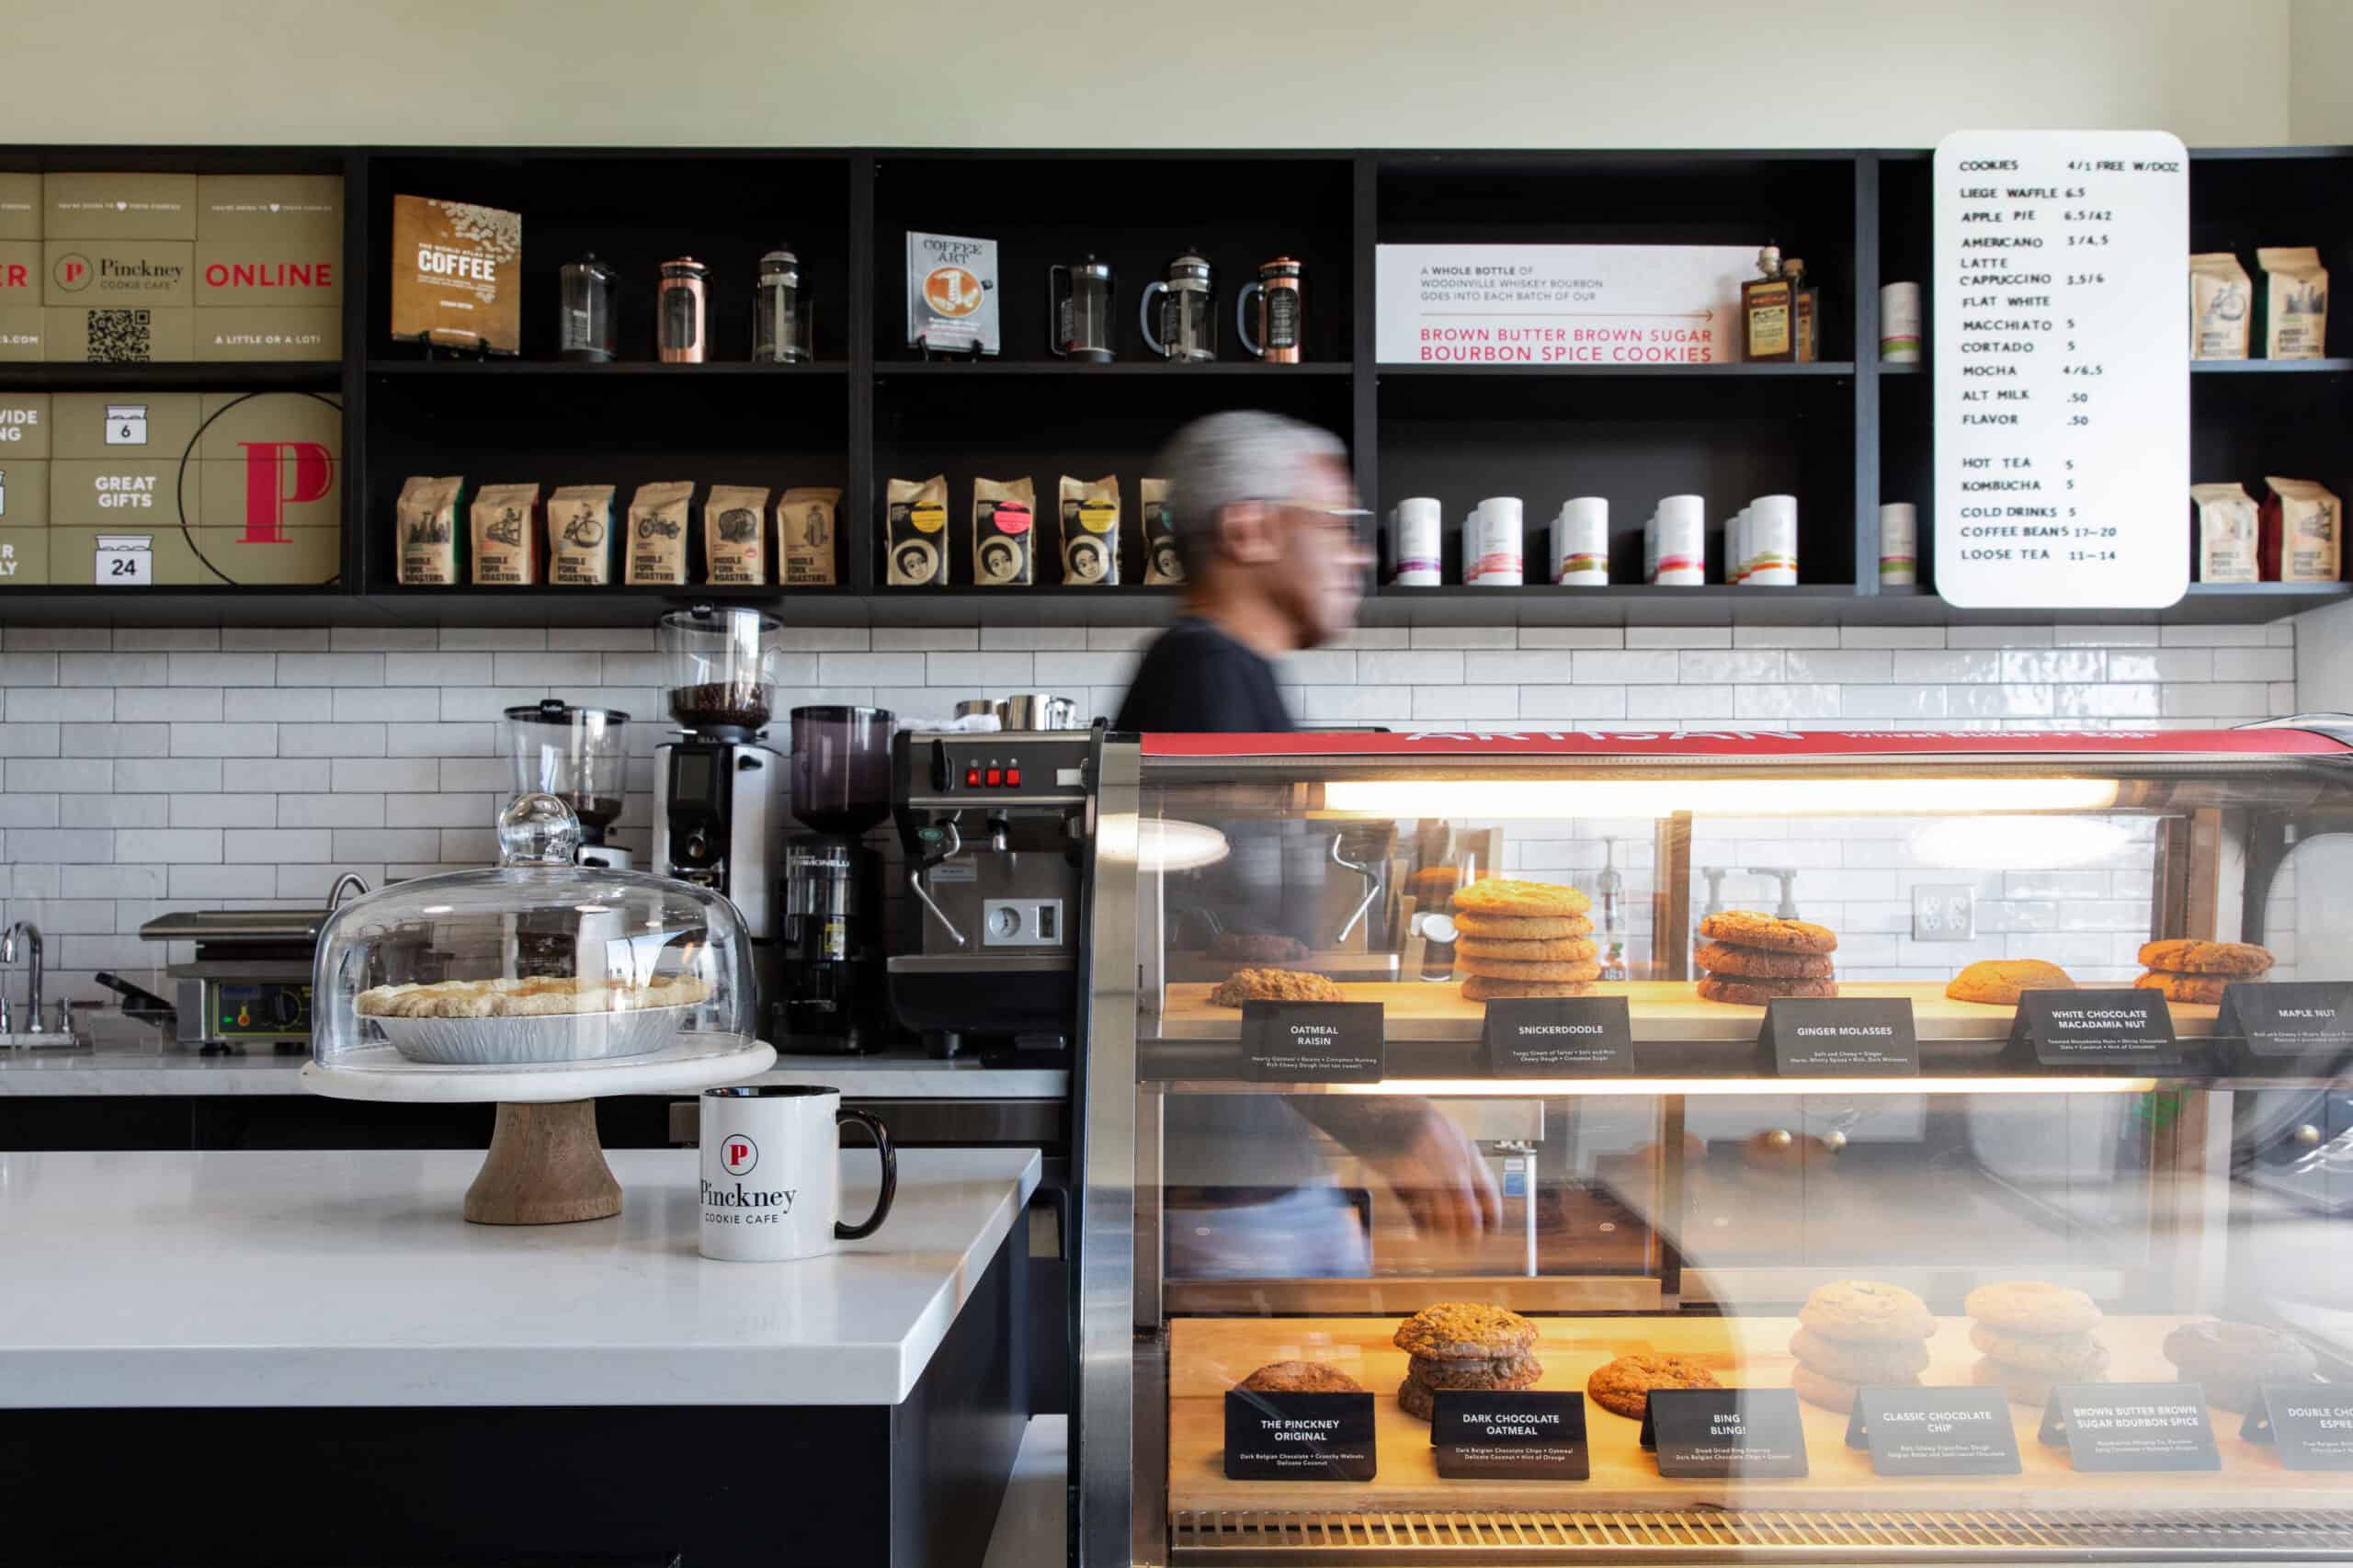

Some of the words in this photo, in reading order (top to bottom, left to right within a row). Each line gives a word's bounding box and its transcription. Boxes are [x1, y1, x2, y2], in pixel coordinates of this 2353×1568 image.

[1959, 160, 2019, 172] COOKIES
[2096, 161, 2126, 172] FREE
[2132, 161, 2180, 173] W/DOZ
[1960, 187, 1998, 199] LIEGE
[2006, 187, 2059, 199] WAFFLE
[2064, 187, 2086, 199] 6.5
[1961, 211, 2004, 223] APPLE
[2013, 210, 2037, 222] PIE
[1961, 237, 2044, 249] AMERICANO
[418, 249, 496, 281] COFFEE
[1960, 257, 2009, 269] LATTE
[101, 258, 184, 284] Pinckney
[205, 264, 332, 288] ONLINE
[1420, 267, 1429, 276] A
[1431, 267, 1471, 276] WHOLE
[1475, 267, 1516, 276] BOTTLE
[1518, 267, 1534, 276] OF
[1420, 278, 1495, 289] WOODINVILLE
[1500, 278, 1546, 289] WHISKEY
[1550, 278, 1604, 289] BOURBON
[1960, 274, 2052, 286] CAPPUCCINO
[1420, 291, 1450, 301] GOES
[1454, 291, 1481, 301] INTO
[1483, 291, 1513, 301] EACH
[1517, 291, 1552, 301] BATCH
[1554, 291, 1570, 301] OF
[1573, 291, 1597, 301] OUR
[1962, 297, 1997, 308] FLAT
[2007, 296, 2052, 307] WHITE
[1962, 320, 2052, 332] MACCHIATO
[227, 335, 261, 345] LITTLE
[265, 335, 280, 345] OR
[1420, 329, 1490, 341] BROWN
[1498, 329, 1566, 341] BUTTER
[1574, 329, 1643, 342] BROWN
[1650, 329, 1711, 343] SUGAR
[1961, 341, 2035, 354] CORTADO
[1420, 346, 1531, 361] BOURBON
[1541, 346, 1602, 361] SPICE
[1612, 347, 1711, 362] COOKIES
[1962, 365, 2018, 377] MOCHA
[1962, 391, 1989, 402] ALT
[1997, 390, 2030, 401] MILK
[1962, 415, 2019, 426] FLAVOR
[120, 425, 131, 438] 6
[1962, 458, 1993, 469] HOT
[2003, 458, 2032, 469] TEA
[95, 476, 156, 492] GREAT
[1961, 481, 2041, 493] KOMBUCHA
[235, 442, 334, 543] P
[98, 494, 153, 508] GIFTS
[1961, 507, 2002, 518] COLD
[2006, 506, 2058, 518] DRINKS
[1961, 527, 2019, 538] COFFEE
[2023, 527, 2069, 538] BEANS
[1961, 549, 2013, 561] LOOSE
[2021, 549, 2051, 560] TEA
[111, 559, 137, 575] 24
[2052, 1010, 2084, 1018] WHITE
[2086, 1010, 2147, 1018] CHOCOLATE
[1290, 1026, 1338, 1035] OATMEAL
[1519, 1026, 1603, 1035] SNICKERDOODLE
[1797, 1027, 1836, 1036] GINGER
[1839, 1027, 1893, 1036] MOLASSES
[1298, 1037, 1331, 1046] RAISIN
[730, 1144, 748, 1165] P
[700, 1179, 797, 1214] Pinckney
[705, 1213, 740, 1224] COOKIE
[745, 1214, 779, 1223] CAFE
[1883, 1412, 1927, 1421] CLASSIC
[1929, 1412, 1992, 1421] CHOCOLATE
[2074, 1407, 2113, 1416] BROWN
[2116, 1406, 2154, 1415] BUTTER
[2157, 1405, 2197, 1415] BROWN
[2288, 1408, 2331, 1416] DOUBLE
[1261, 1420, 1281, 1428] THE
[1285, 1420, 1339, 1428] PINCKNEY
[1463, 1415, 1492, 1423] DARK
[1495, 1415, 1560, 1424] CHOCOLATE
[1714, 1415, 1741, 1423] BING
[2076, 1418, 2113, 1428] SUGAR
[2116, 1418, 2169, 1427] BOURBON
[2170, 1417, 2199, 1426] SPICE
[1486, 1426, 1538, 1435] OATMEAL
[1711, 1426, 1746, 1435] BLING!
[1927, 1425, 1952, 1433] CHIP
[1274, 1432, 1326, 1441] ORIGINAL
